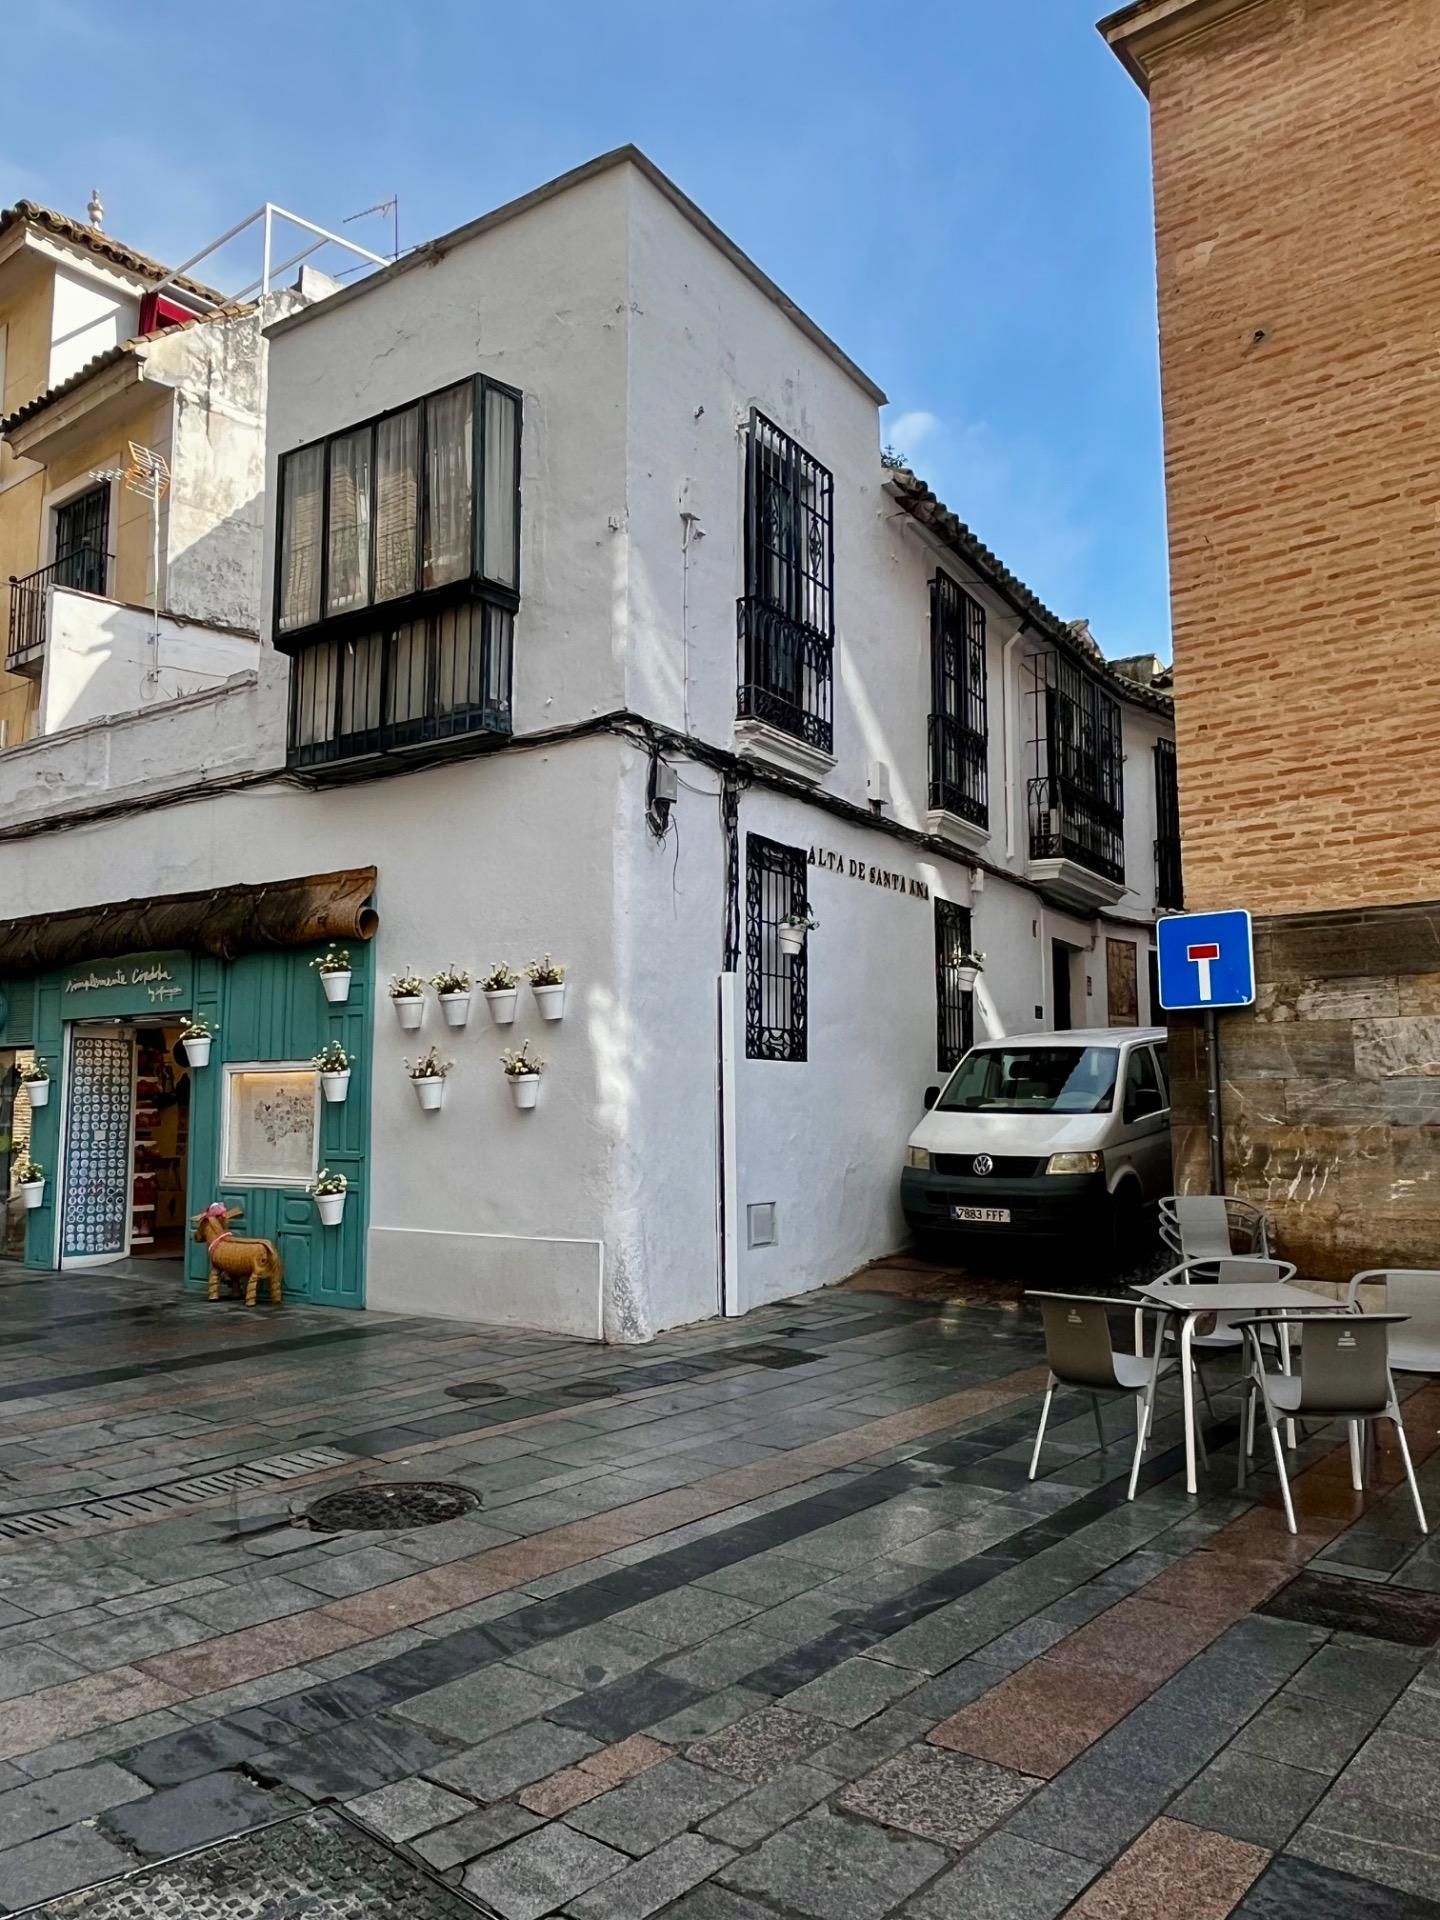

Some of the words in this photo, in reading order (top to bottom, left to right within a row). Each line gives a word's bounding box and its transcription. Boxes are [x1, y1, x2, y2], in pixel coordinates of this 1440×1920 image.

[808, 846, 844, 873] ALTA
[849, 859, 865, 880] DE
[869, 867, 905, 893] SANTA
[909, 878, 929, 900] ANA
[957, 1207, 983, 1219] 7883
[986, 1209, 1004, 1221] FFF
